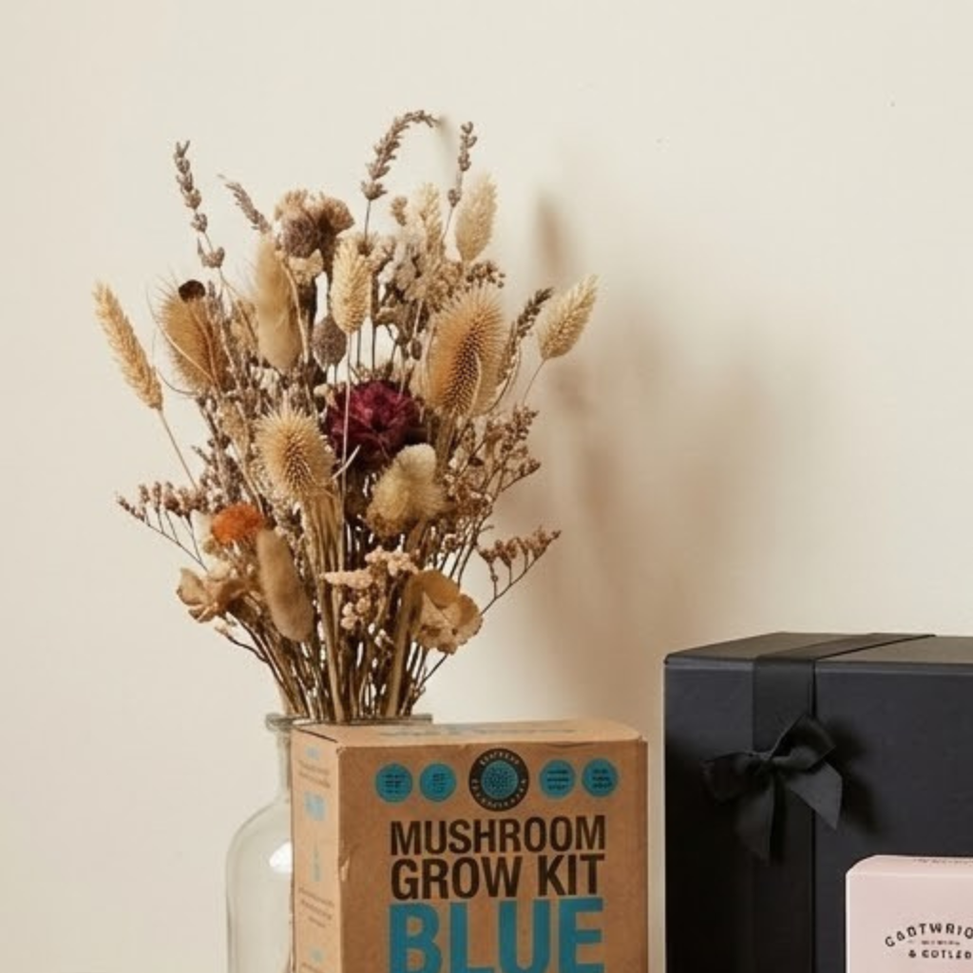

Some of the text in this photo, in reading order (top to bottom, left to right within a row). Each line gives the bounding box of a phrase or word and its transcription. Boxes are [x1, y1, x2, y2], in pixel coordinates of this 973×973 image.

[390, 815, 606, 855] MUSHROOM
[391, 854, 605, 901] GROW KIT
